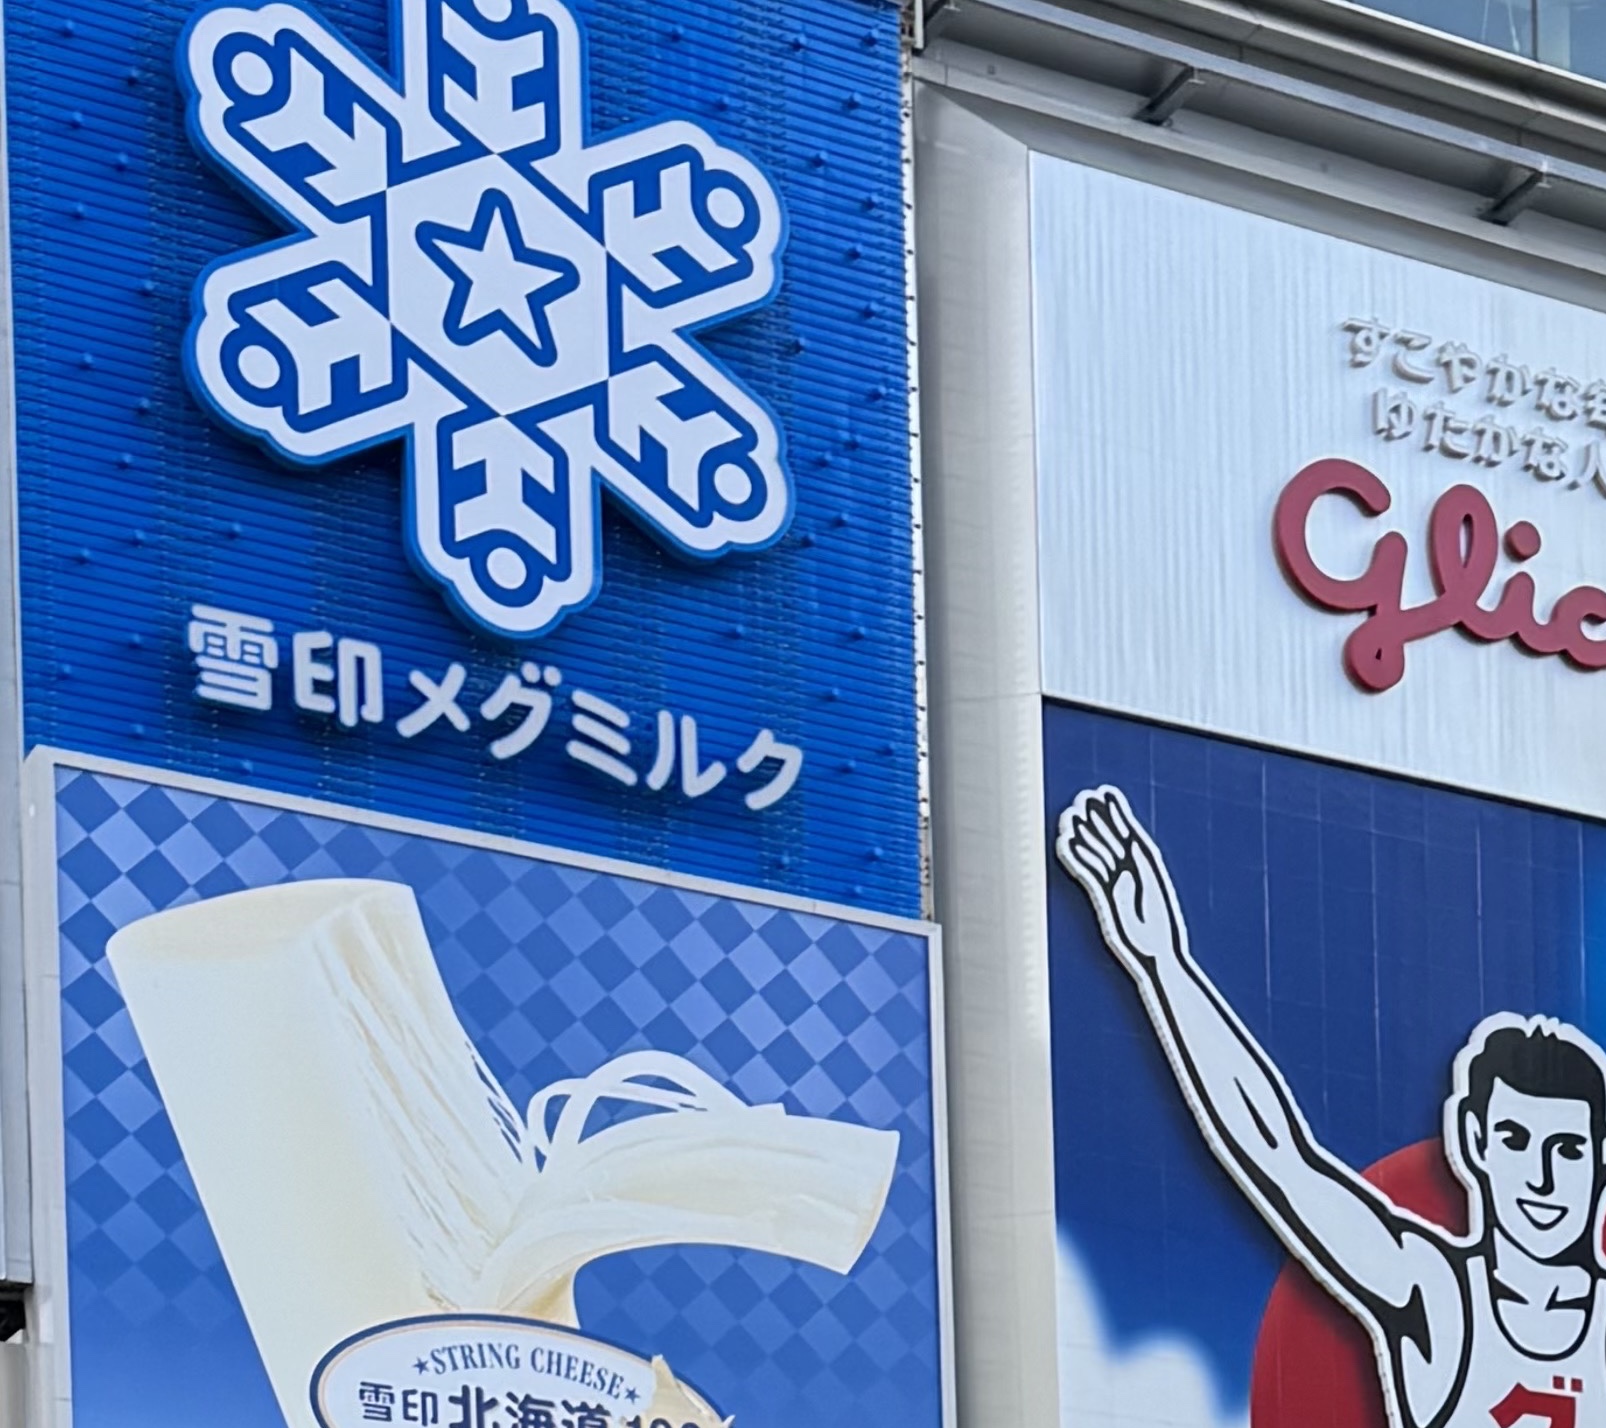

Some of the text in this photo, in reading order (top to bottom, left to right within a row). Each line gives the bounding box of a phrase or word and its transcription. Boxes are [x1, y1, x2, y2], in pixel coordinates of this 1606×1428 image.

[187, 603, 804, 810] 雪印メグミルク
[430, 1342, 626, 1402] STRING CHEESE
